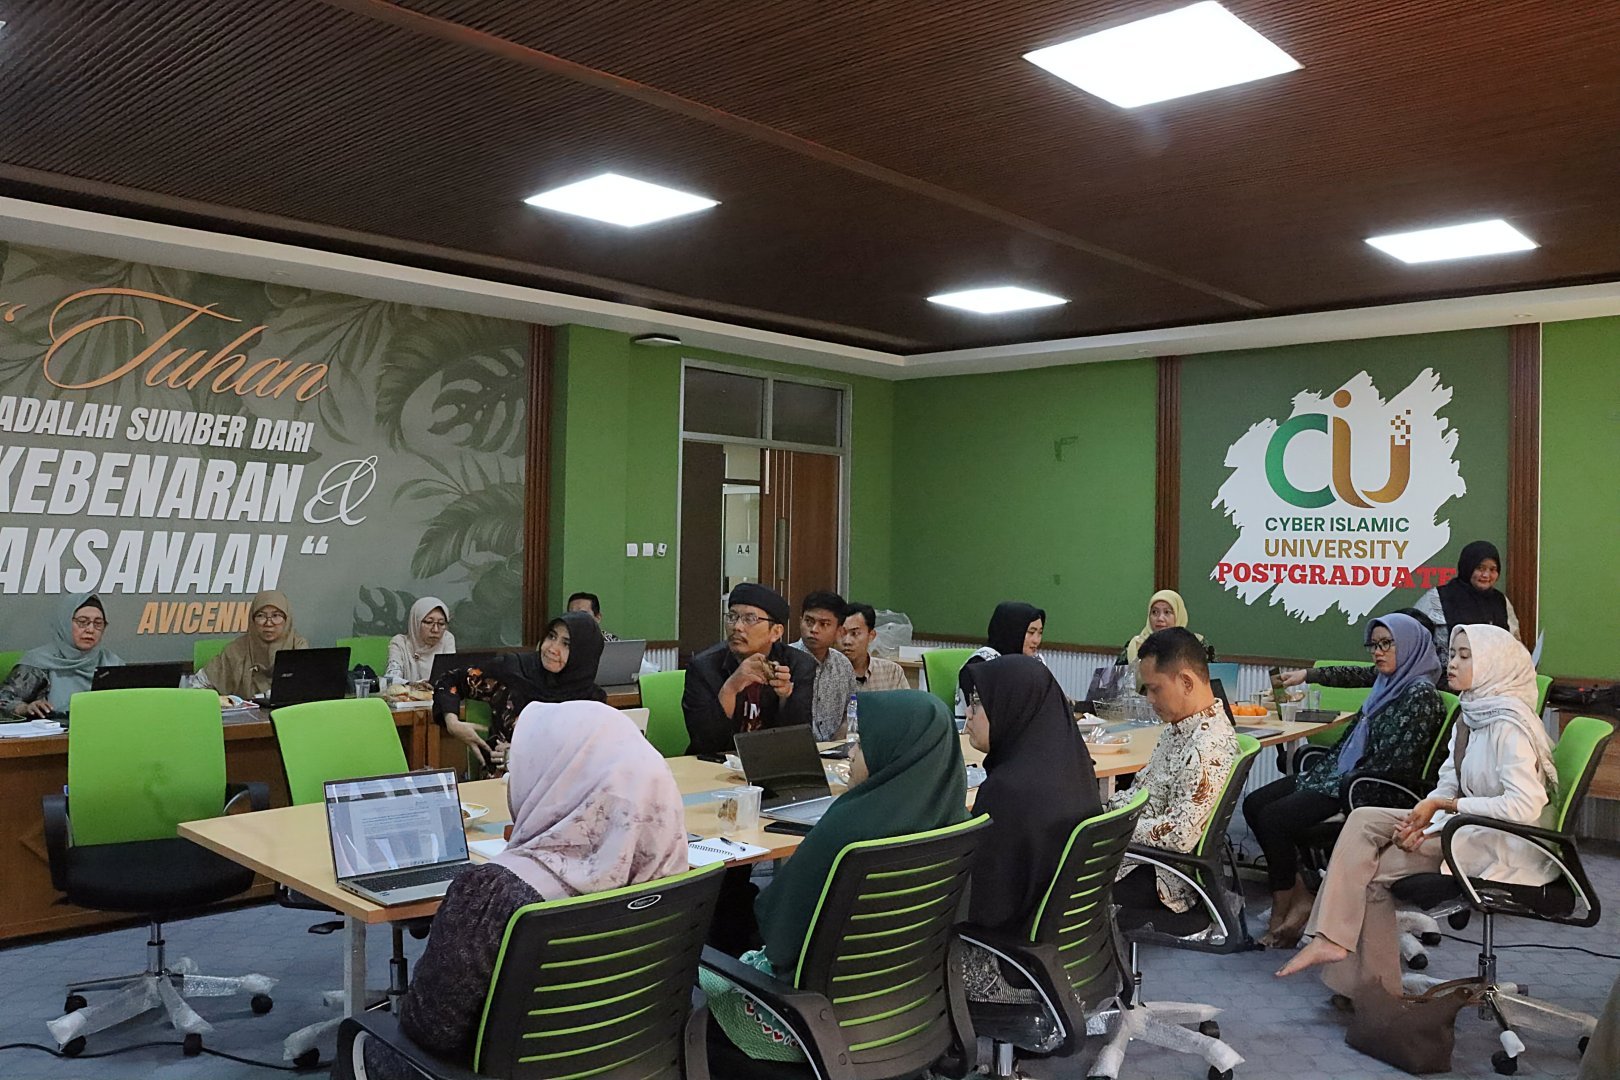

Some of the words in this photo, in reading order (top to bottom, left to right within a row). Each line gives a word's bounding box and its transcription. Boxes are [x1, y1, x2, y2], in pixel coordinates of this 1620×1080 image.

[44, 287, 328, 401] Tuhan
[0, 396, 121, 439] ADALAH
[126, 407, 247, 448] SUMBER
[251, 418, 314, 453] DARI
[303, 455, 378, 525] &
[1264, 539, 1409, 560] UNIVERSITY
[1265, 517, 1325, 532] CYBER
[1330, 517, 1410, 533] ISLAMIC
[0, 527, 288, 594] AKSANAAN
